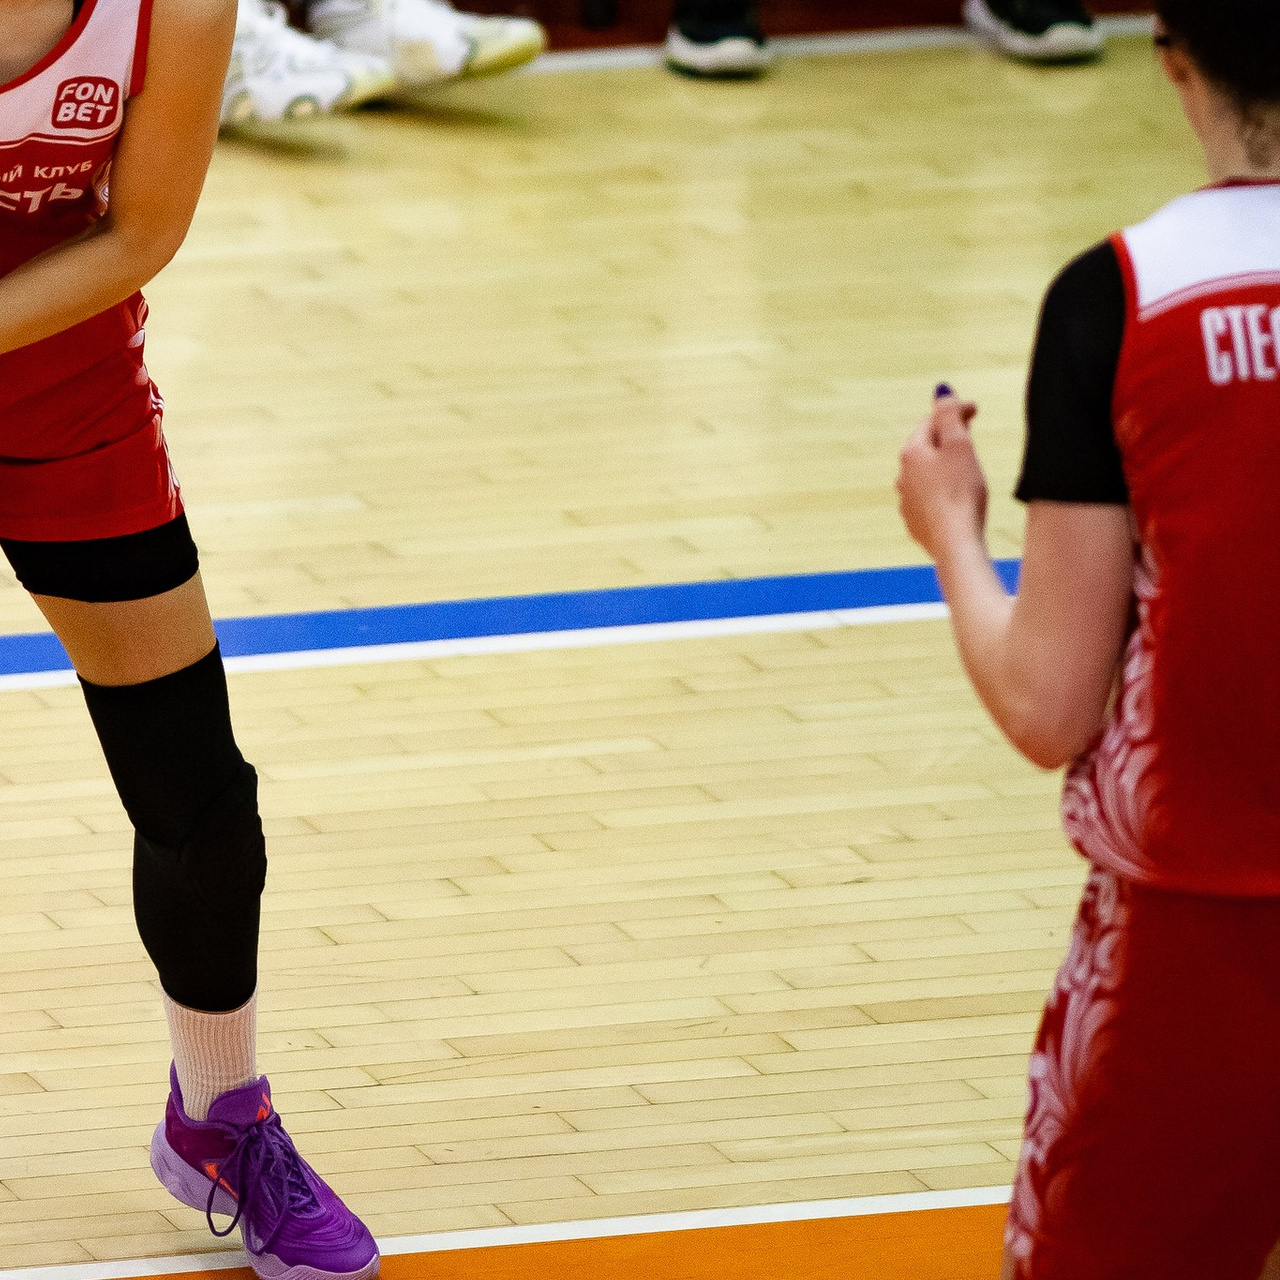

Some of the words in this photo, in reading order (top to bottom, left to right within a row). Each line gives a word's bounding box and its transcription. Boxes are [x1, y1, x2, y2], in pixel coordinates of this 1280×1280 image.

[58, 82, 114, 104] FON
[56, 102, 114, 123] BET
[33, 160, 93, 179] КЛУБ
